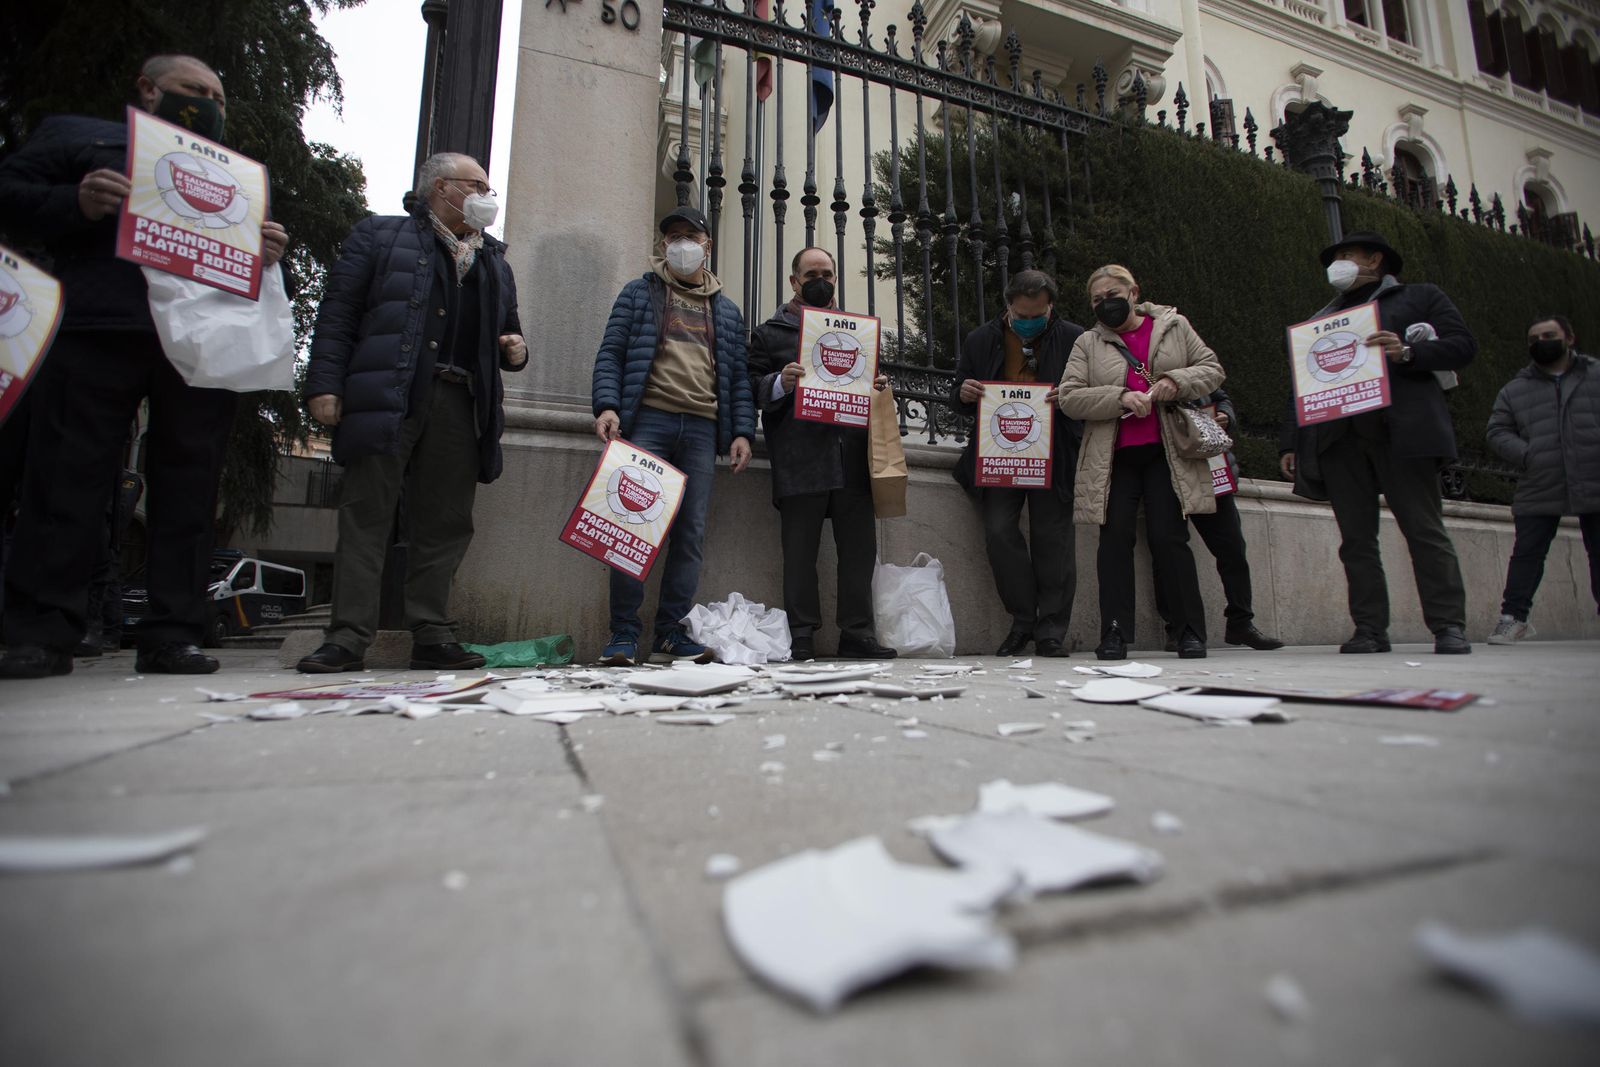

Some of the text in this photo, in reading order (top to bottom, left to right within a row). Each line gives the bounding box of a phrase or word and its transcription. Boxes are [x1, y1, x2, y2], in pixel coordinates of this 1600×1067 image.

[174, 135, 230, 165] 1 AÑO
[135, 217, 253, 266] PAGANDO LOS
[134, 231, 198, 263] PLATOS
[202, 252, 252, 279] ROTOS
[824, 318, 857, 330] 1 AÑO
[1313, 317, 1350, 335] 1 AÑO
[803, 388, 870, 406] PAGANDO LOS
[1001, 389, 1031, 399] 1 AÑO
[1303, 378, 1380, 404] PAGANDO LOS
[1304, 397, 1343, 412] PLATOS
[1345, 388, 1381, 403] ROTOS
[802, 397, 869, 415] PLATOS ROTOS
[631, 454, 664, 476] 1 AÑO
[982, 467, 1046, 476] PLATOS ROTOS
[983, 458, 1046, 467] PAGANDO LOS
[1212, 469, 1226, 478] LOS
[575, 520, 616, 547] PLATOS
[614, 541, 648, 565] ROTOS
[581, 510, 630, 542] PAGANDO
[633, 537, 653, 555] LOS
